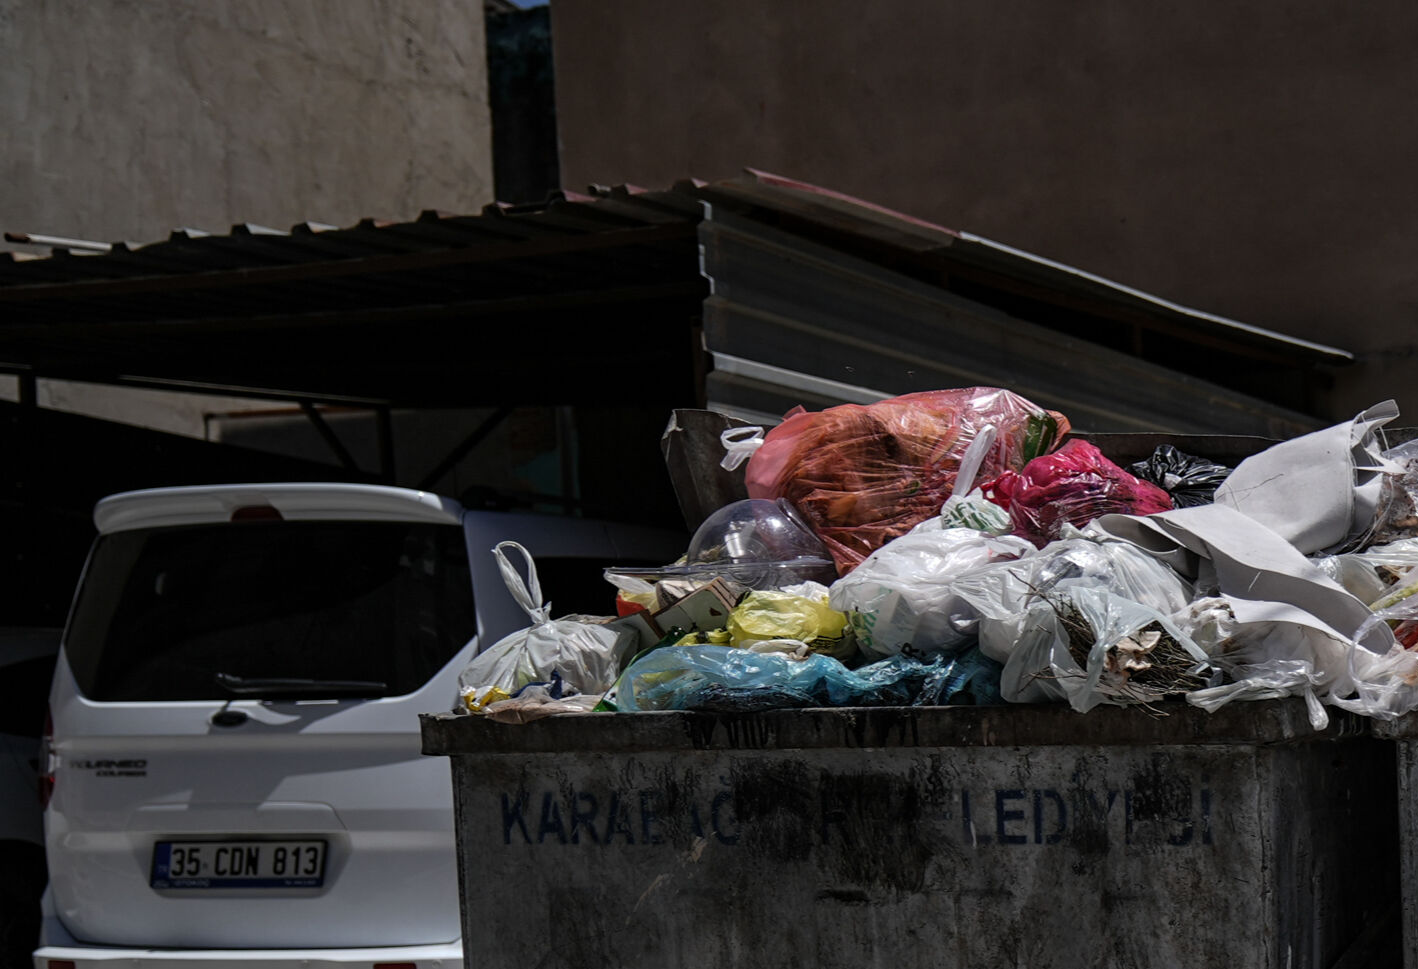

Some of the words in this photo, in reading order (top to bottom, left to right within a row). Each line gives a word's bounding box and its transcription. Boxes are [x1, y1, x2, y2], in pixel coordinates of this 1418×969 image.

[171, 847, 201, 876] 35
[215, 847, 260, 876] CDN
[273, 847, 318, 876] 813
